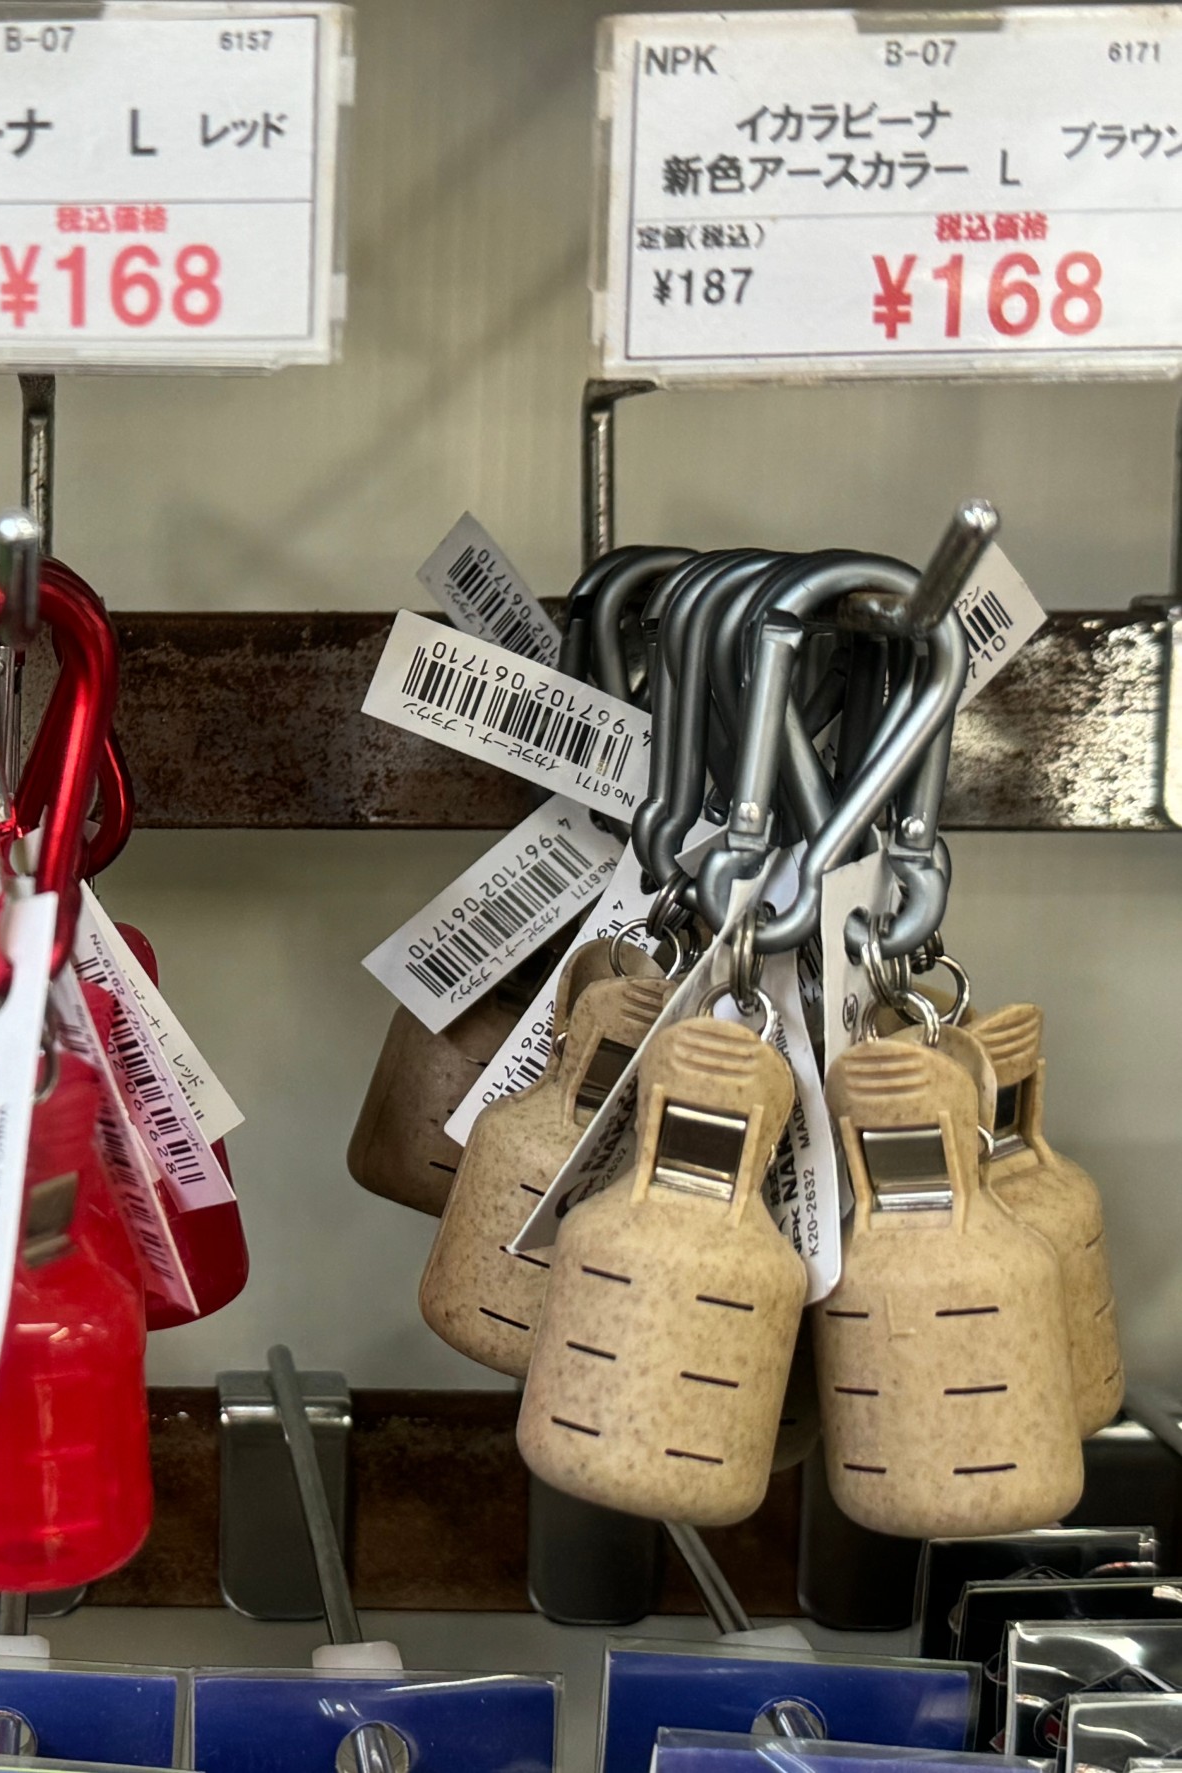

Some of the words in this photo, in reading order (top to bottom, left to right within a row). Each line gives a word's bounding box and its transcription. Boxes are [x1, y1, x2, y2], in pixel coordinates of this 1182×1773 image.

[5, 27, 76, 53] B-07
[644, 45, 717, 76] NPK
[884, 40, 956, 68] B-07
[1108, 42, 1162, 64] 6171
[130, 109, 157, 157] L
[199, 111, 288, 150] レッド
[736, 100, 951, 143] イカラビーナ
[662, 150, 969, 195] 新色アースカラー
[1000, 150, 1022, 188] L
[55, 206, 168, 234] 税込価格
[934, 212, 1049, 242] 税込価格
[653, 269, 753, 306] ¥187
[871, 251, 1103, 340] ¥168
[477, 549, 532, 620] 061710
[530, 621, 560, 659] 102
[429, 638, 526, 693] 061710
[399, 697, 459, 732] ブラウン
[531, 680, 629, 735] 967102
[460, 722, 474, 738] L
[476, 728, 561, 775] イカラビーナ
[573, 770, 636, 807] No.6171
[555, 814, 573, 832] 4
[478, 831, 553, 900] 967102
[568, 856, 618, 901] No.6171
[611, 898, 625, 913] 4
[406, 894, 480, 962] 061710
[499, 901, 564, 961] イカラビーナ
[489, 956, 502, 970] L
[445, 964, 492, 1007] ブラウン
[123, 1004, 170, 1088] イカラビーナ
[178, 1115, 203, 1155] レッド
[171, 1051, 204, 1091] レッド
[479, 1019, 545, 1106] 061710
[125, 1082, 178, 1175] 061628
[802, 1167, 818, 1256] K20-2632
